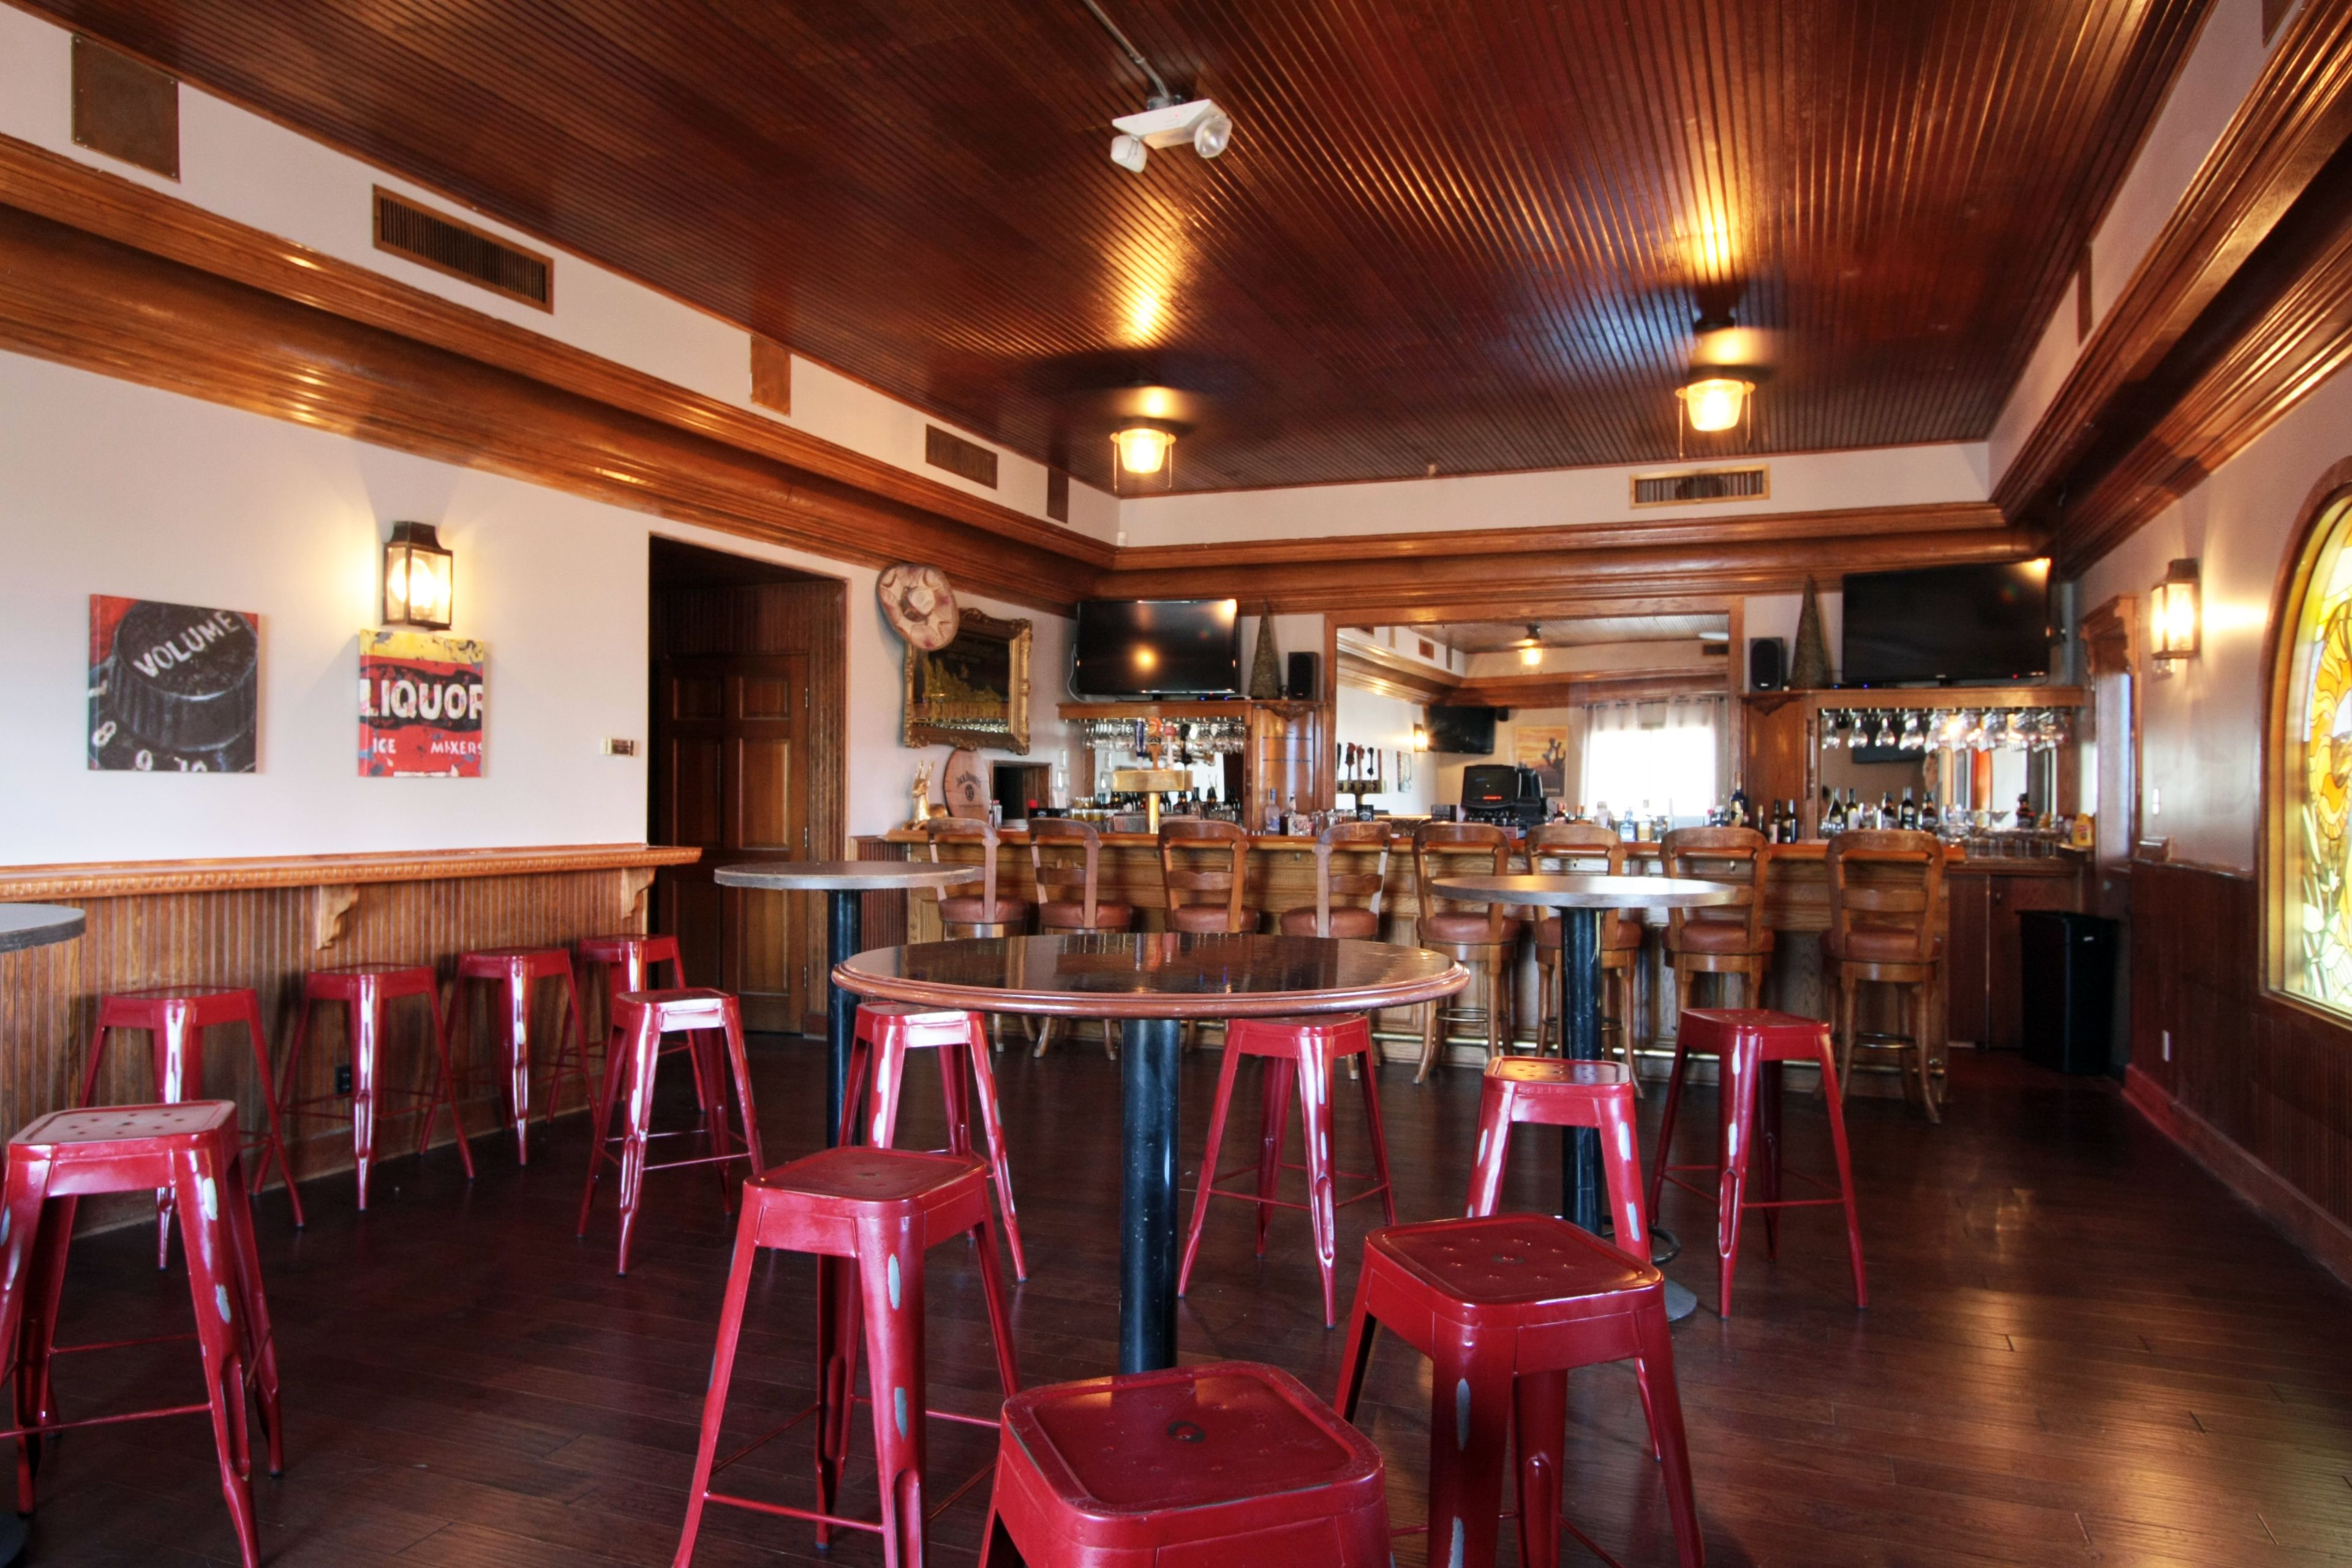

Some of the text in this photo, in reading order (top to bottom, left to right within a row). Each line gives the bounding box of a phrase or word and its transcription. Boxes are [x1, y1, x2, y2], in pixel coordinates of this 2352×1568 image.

[133, 611, 240, 677] VOLUME
[359, 679, 483, 720] LIQUOR
[92, 721, 117, 747] 8
[135, 749, 153, 771] 9
[373, 737, 396, 754] ICE
